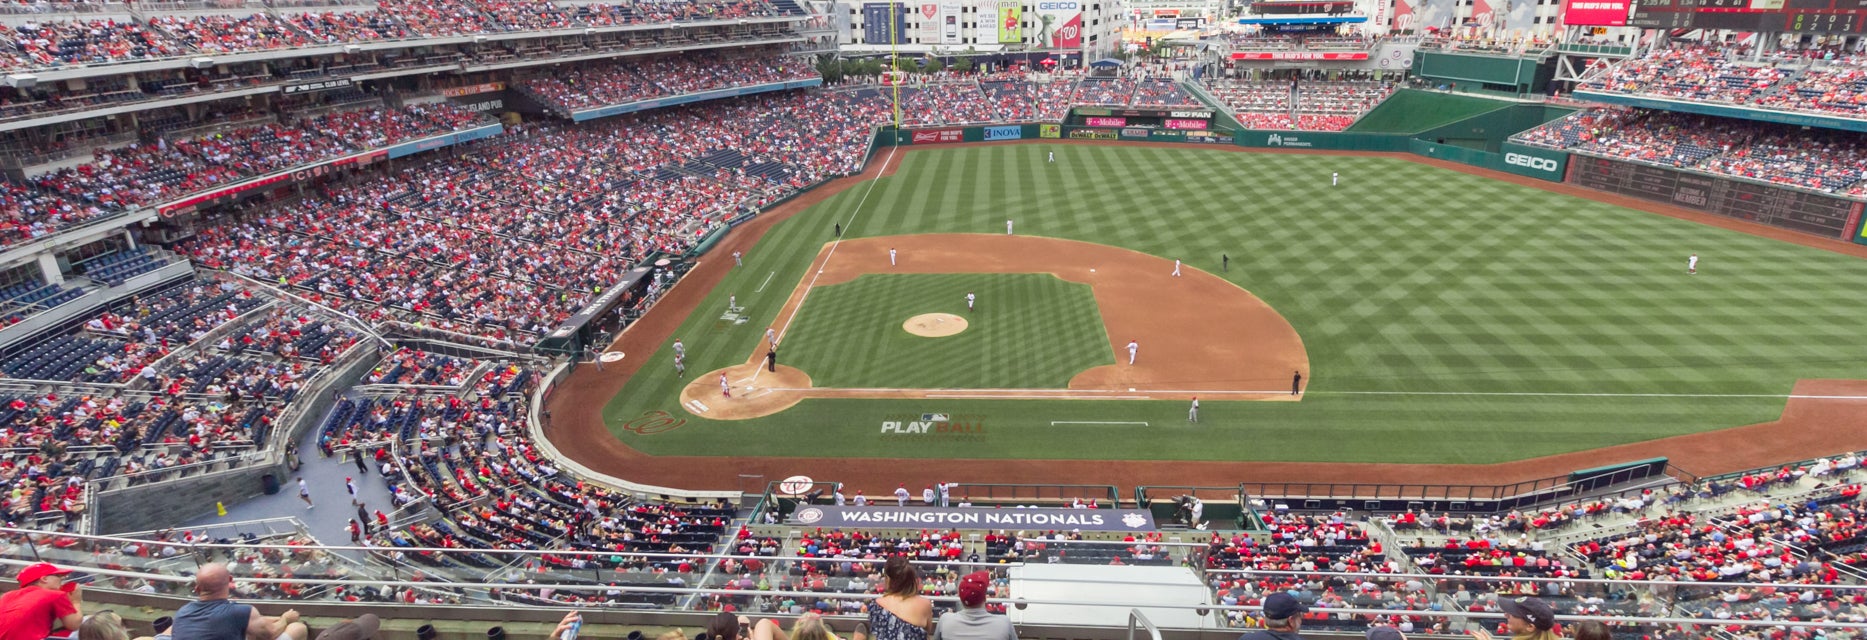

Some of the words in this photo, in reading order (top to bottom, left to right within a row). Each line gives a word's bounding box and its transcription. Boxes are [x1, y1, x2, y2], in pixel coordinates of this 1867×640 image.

[1040, 2, 1077, 10] GEICO
[1829, 15, 1836, 23] 0
[1794, 22, 1802, 30] 0
[993, 128, 1020, 137] INOVA
[1505, 152, 1558, 172] GEICO
[1674, 192, 1707, 206] MEMBER
[880, 421, 933, 434] PLAY
[935, 421, 984, 434] BALL
[841, 511, 979, 523] WASHINGTON
[985, 513, 1104, 525] NATIONALS
